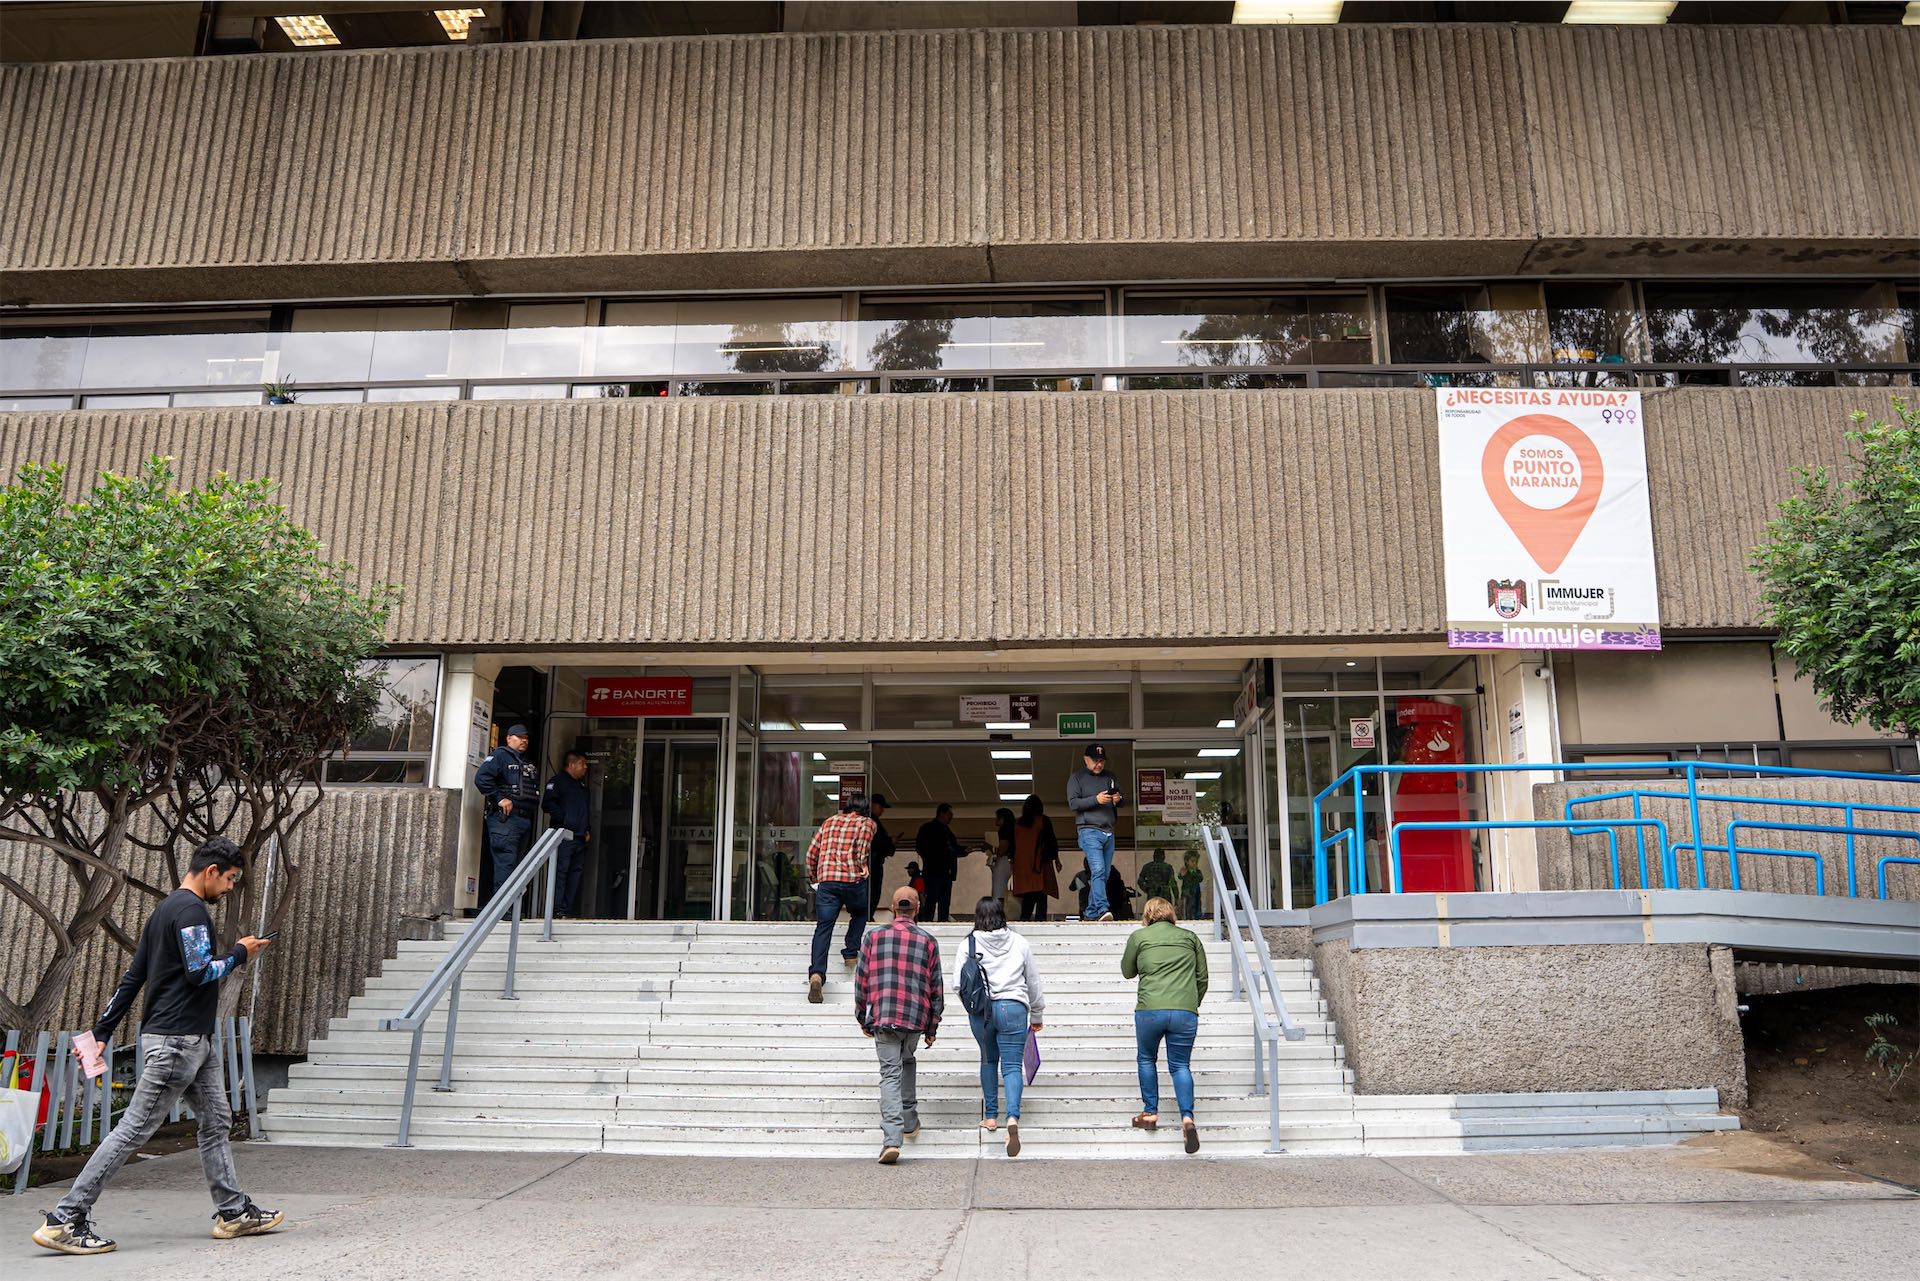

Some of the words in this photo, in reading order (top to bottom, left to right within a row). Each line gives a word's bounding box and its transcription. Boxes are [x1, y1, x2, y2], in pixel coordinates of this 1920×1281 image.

[1446, 390, 1552, 407] ¿NECESITAS
[1557, 392, 1628, 407] AYUDA?
[1520, 449, 1563, 459] SOMOS
[1513, 460, 1574, 475] PUNTO
[1510, 476, 1579, 488] NARANJA
[1547, 587, 1605, 599] IMMUJER
[1503, 623, 1605, 648] immujer
[612, 689, 687, 699] BANORTE
